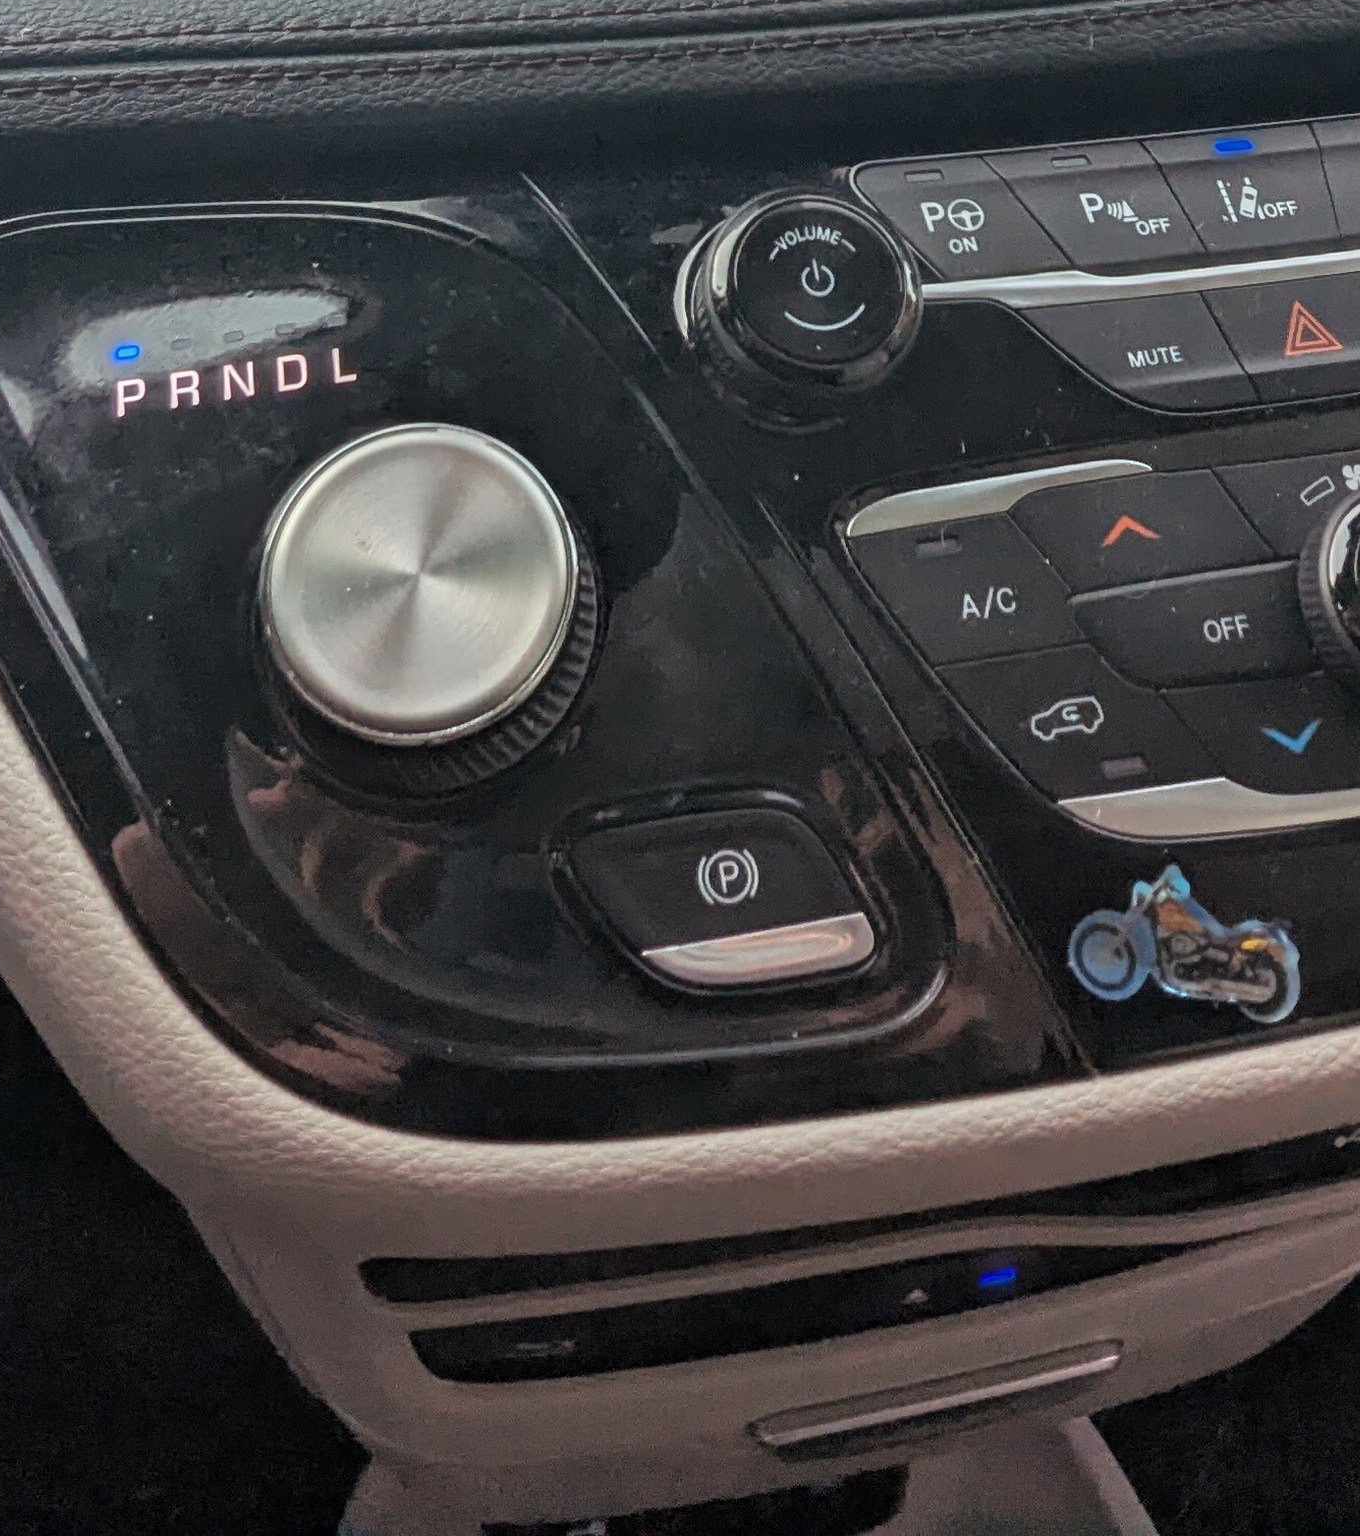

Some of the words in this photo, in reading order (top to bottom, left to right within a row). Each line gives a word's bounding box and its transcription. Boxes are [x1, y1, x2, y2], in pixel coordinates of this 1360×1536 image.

[920, 201, 944, 233] P
[1080, 193, 1104, 224] P
[1135, 216, 1171, 237] OFF
[1263, 199, 1299, 219] OFF
[774, 225, 843, 251] VOLUME
[948, 235, 980, 254] ON
[1127, 345, 1183, 369] MUTE
[961, 586, 1016, 620] A/C
[1202, 614, 1249, 643] OFF
